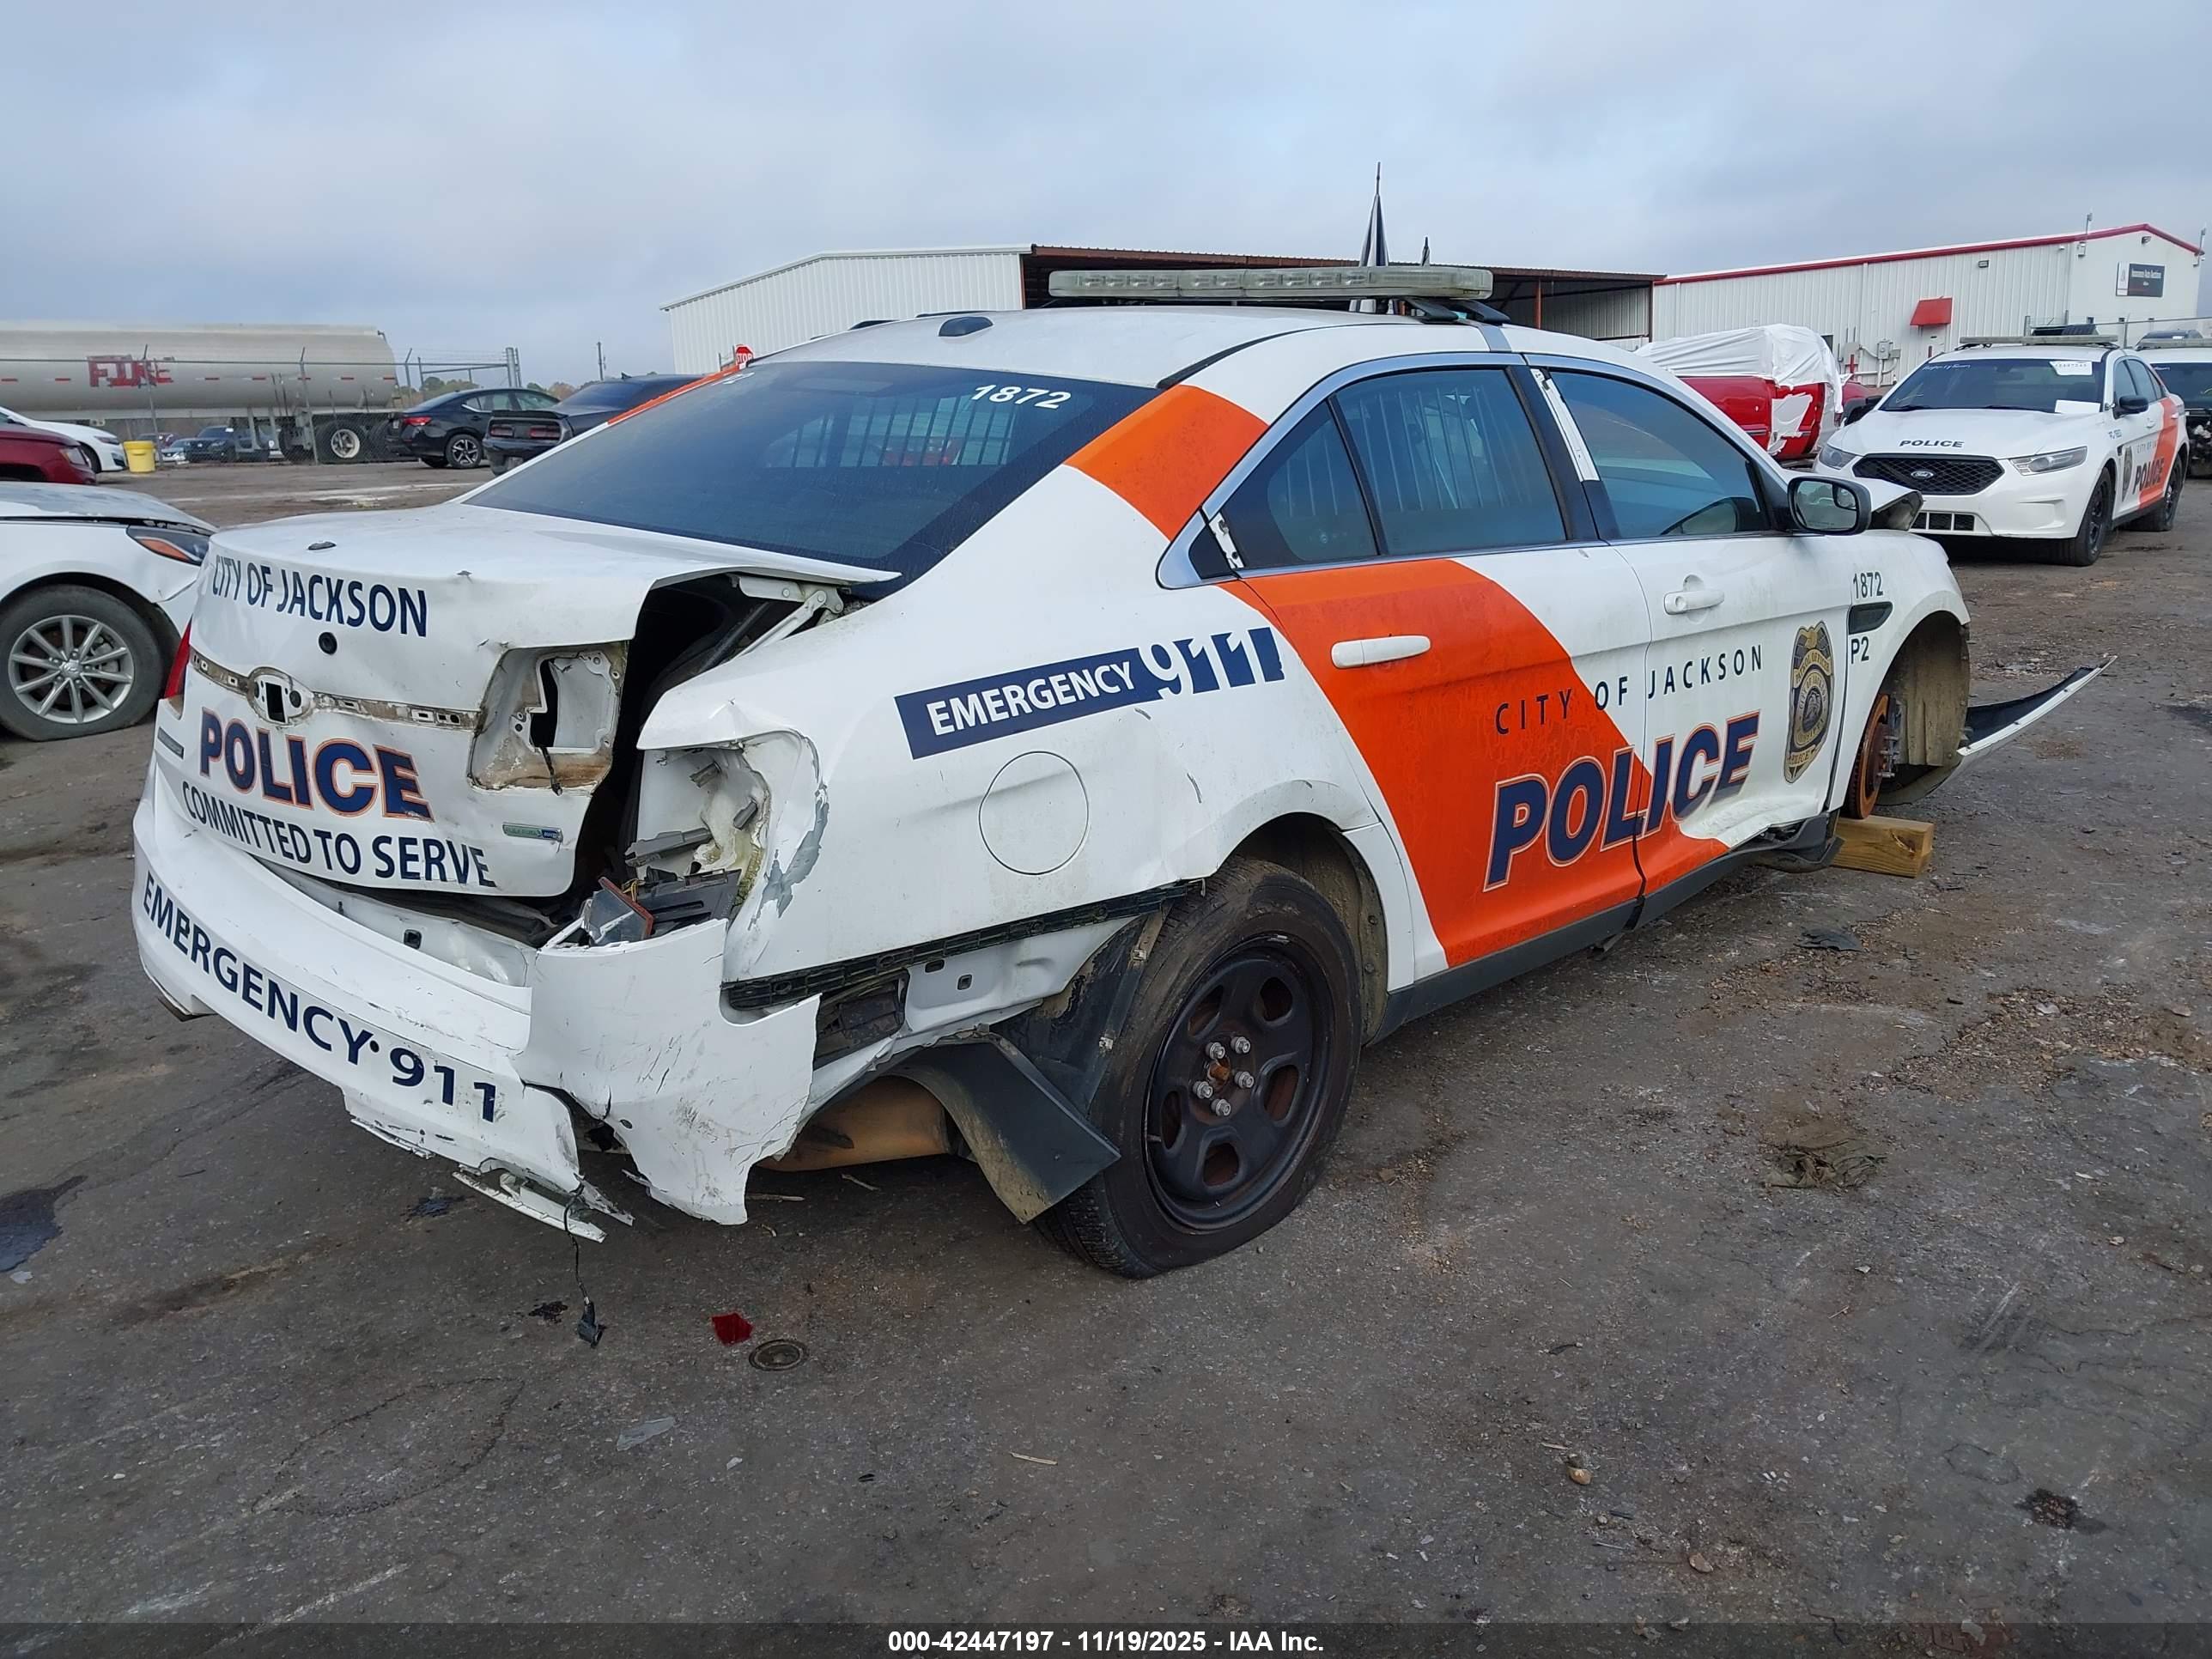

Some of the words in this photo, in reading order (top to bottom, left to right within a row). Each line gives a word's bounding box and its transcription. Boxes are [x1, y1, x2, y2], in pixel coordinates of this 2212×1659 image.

[971, 384, 1072, 410] 1872
[1899, 440, 1965, 448] POLICE
[2132, 456, 2165, 495] POLICE
[212, 554, 241, 600] CITY
[246, 562, 273, 607] OF
[276, 568, 428, 637] JACKSON
[1852, 571, 1884, 599] 1872
[926, 661, 1136, 736] EMERGENCY
[1139, 629, 1267, 699] 911
[1495, 689, 1572, 735] CITY
[1595, 675, 1628, 711] OF
[1648, 644, 1762, 699] JACKSON
[1850, 635, 1869, 664] P2
[199, 706, 434, 823] POLICE
[1483, 708, 1760, 893] POLICE
[182, 781, 312, 864] COMMITTED
[313, 830, 362, 874] TO
[372, 836, 497, 888] SERVE
[143, 869, 374, 1066] EMERGENCY
[389, 1047, 497, 1123] 911
